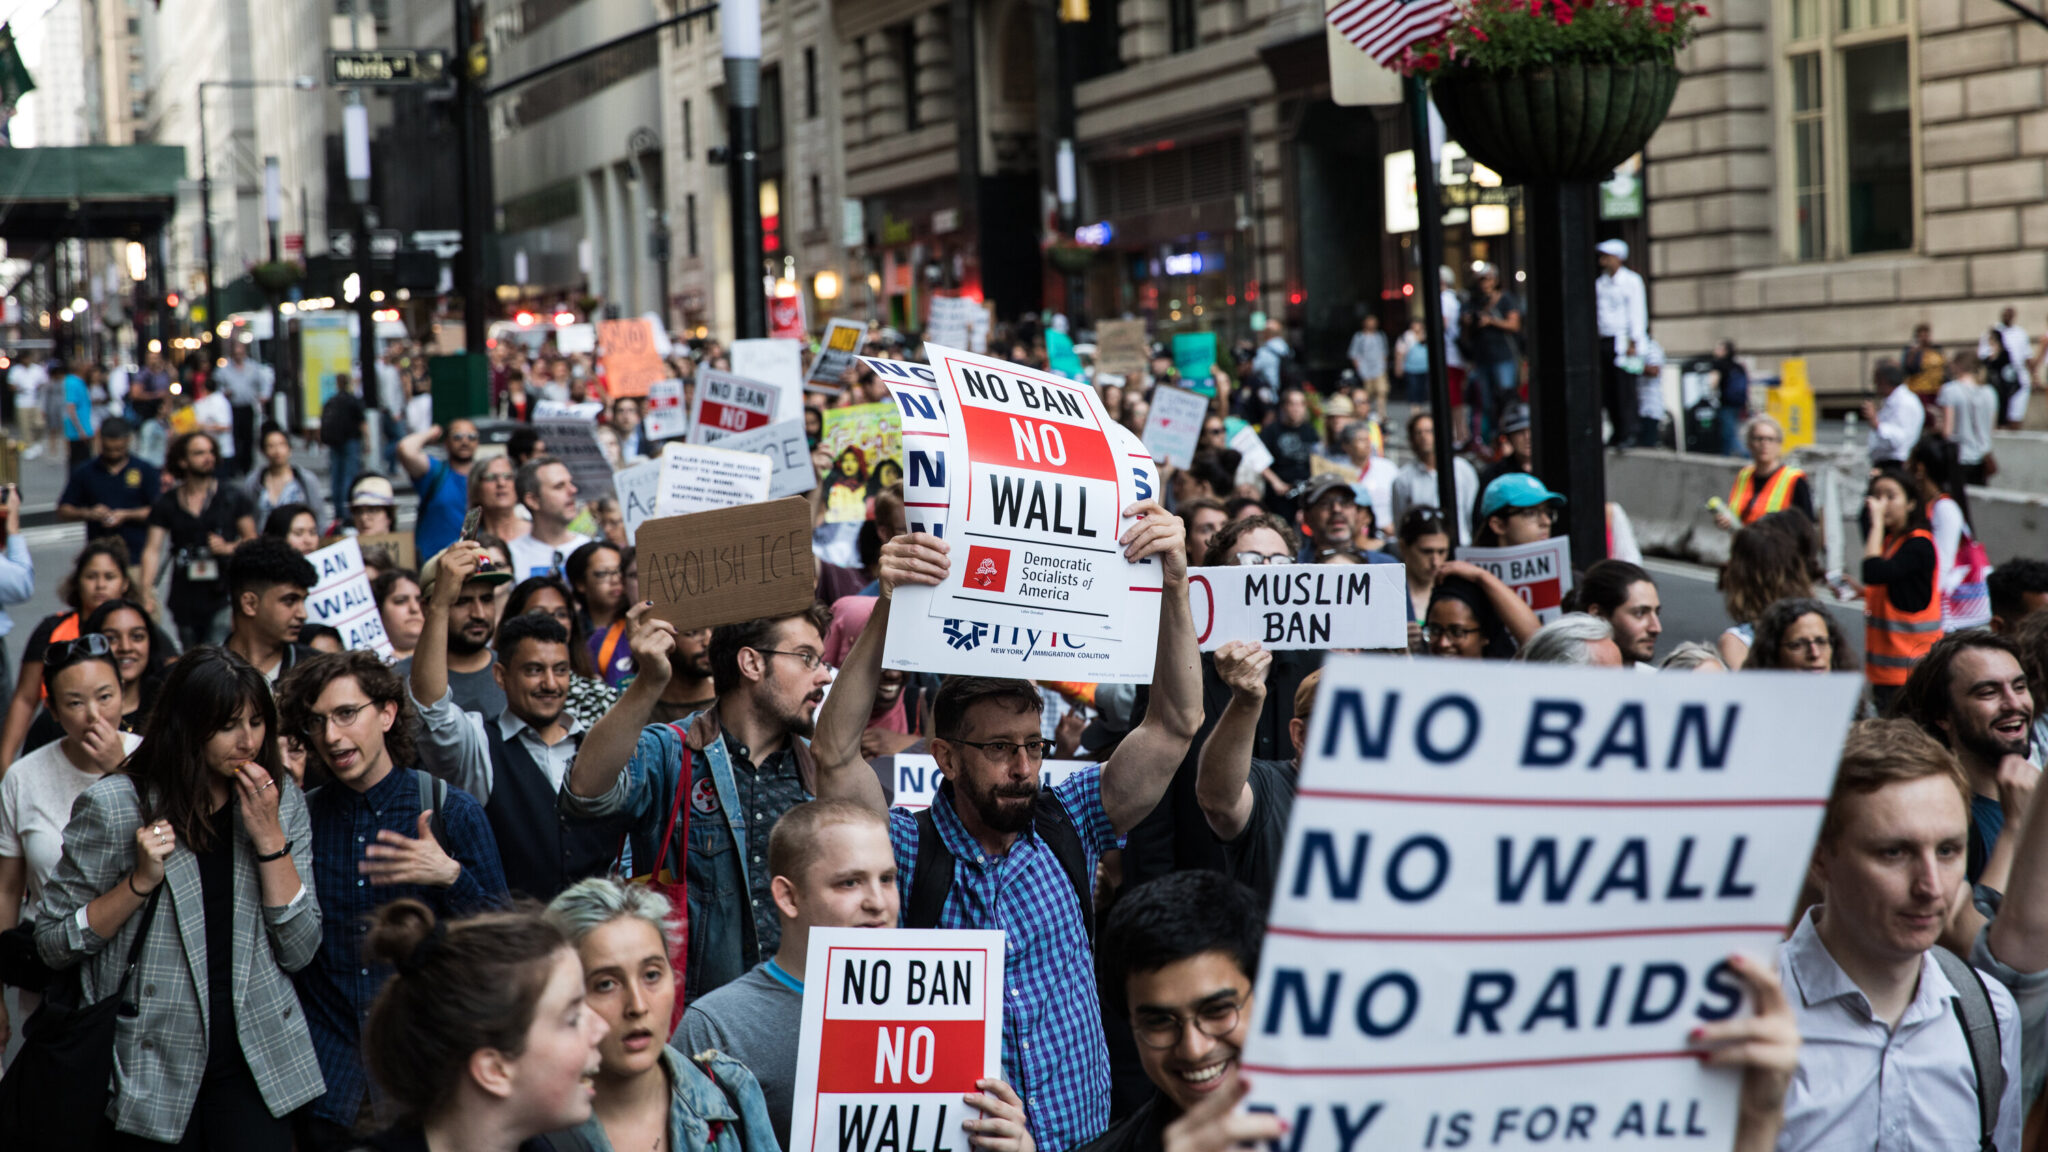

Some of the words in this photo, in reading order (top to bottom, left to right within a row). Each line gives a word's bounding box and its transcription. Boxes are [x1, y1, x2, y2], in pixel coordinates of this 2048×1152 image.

[336, 58, 392, 79] Morris
[867, 360, 936, 382] NO
[710, 382, 731, 399] NO
[735, 386, 767, 407] BAN
[896, 391, 946, 420] N
[962, 368, 1009, 403] NO
[1016, 380, 1084, 419] BAN
[720, 407, 747, 430] NO
[1009, 417, 1067, 466] NO
[707, 487, 742, 498] FORWARD
[990, 474, 1097, 538] WALL
[324, 551, 348, 578] AN
[647, 544, 746, 604] ABOLISH
[755, 530, 804, 584] ICE
[1022, 567, 1078, 586] Socialists
[1083, 578, 1094, 590] of
[1024, 552, 1092, 572] Democratic
[1510, 556, 1550, 580] BAN
[313, 584, 368, 619] WALL
[1019, 583, 1070, 601] America
[1188, 575, 1214, 644] O
[1245, 572, 1370, 606] MUSLIM
[351, 618, 382, 649] AIDS
[1262, 611, 1330, 644] BAN
[1032, 650, 1076, 658] IMMIGRATION
[1077, 652, 1110, 660] COALITION
[1320, 689, 1481, 766] NO
[1518, 698, 1740, 771] BAN
[1290, 828, 1452, 904] NO
[1495, 836, 1757, 905] WALL
[842, 959, 891, 1005] NO
[906, 960, 971, 1005] BAN
[1262, 965, 1421, 1039] NO
[1454, 958, 1745, 1036] RAIDS
[874, 1026, 935, 1084] NO
[838, 1104, 953, 1152] WALL
[1423, 1111, 1474, 1149] IS
[1491, 1103, 1598, 1146] FOR
[1613, 1099, 1708, 1139] ALL
